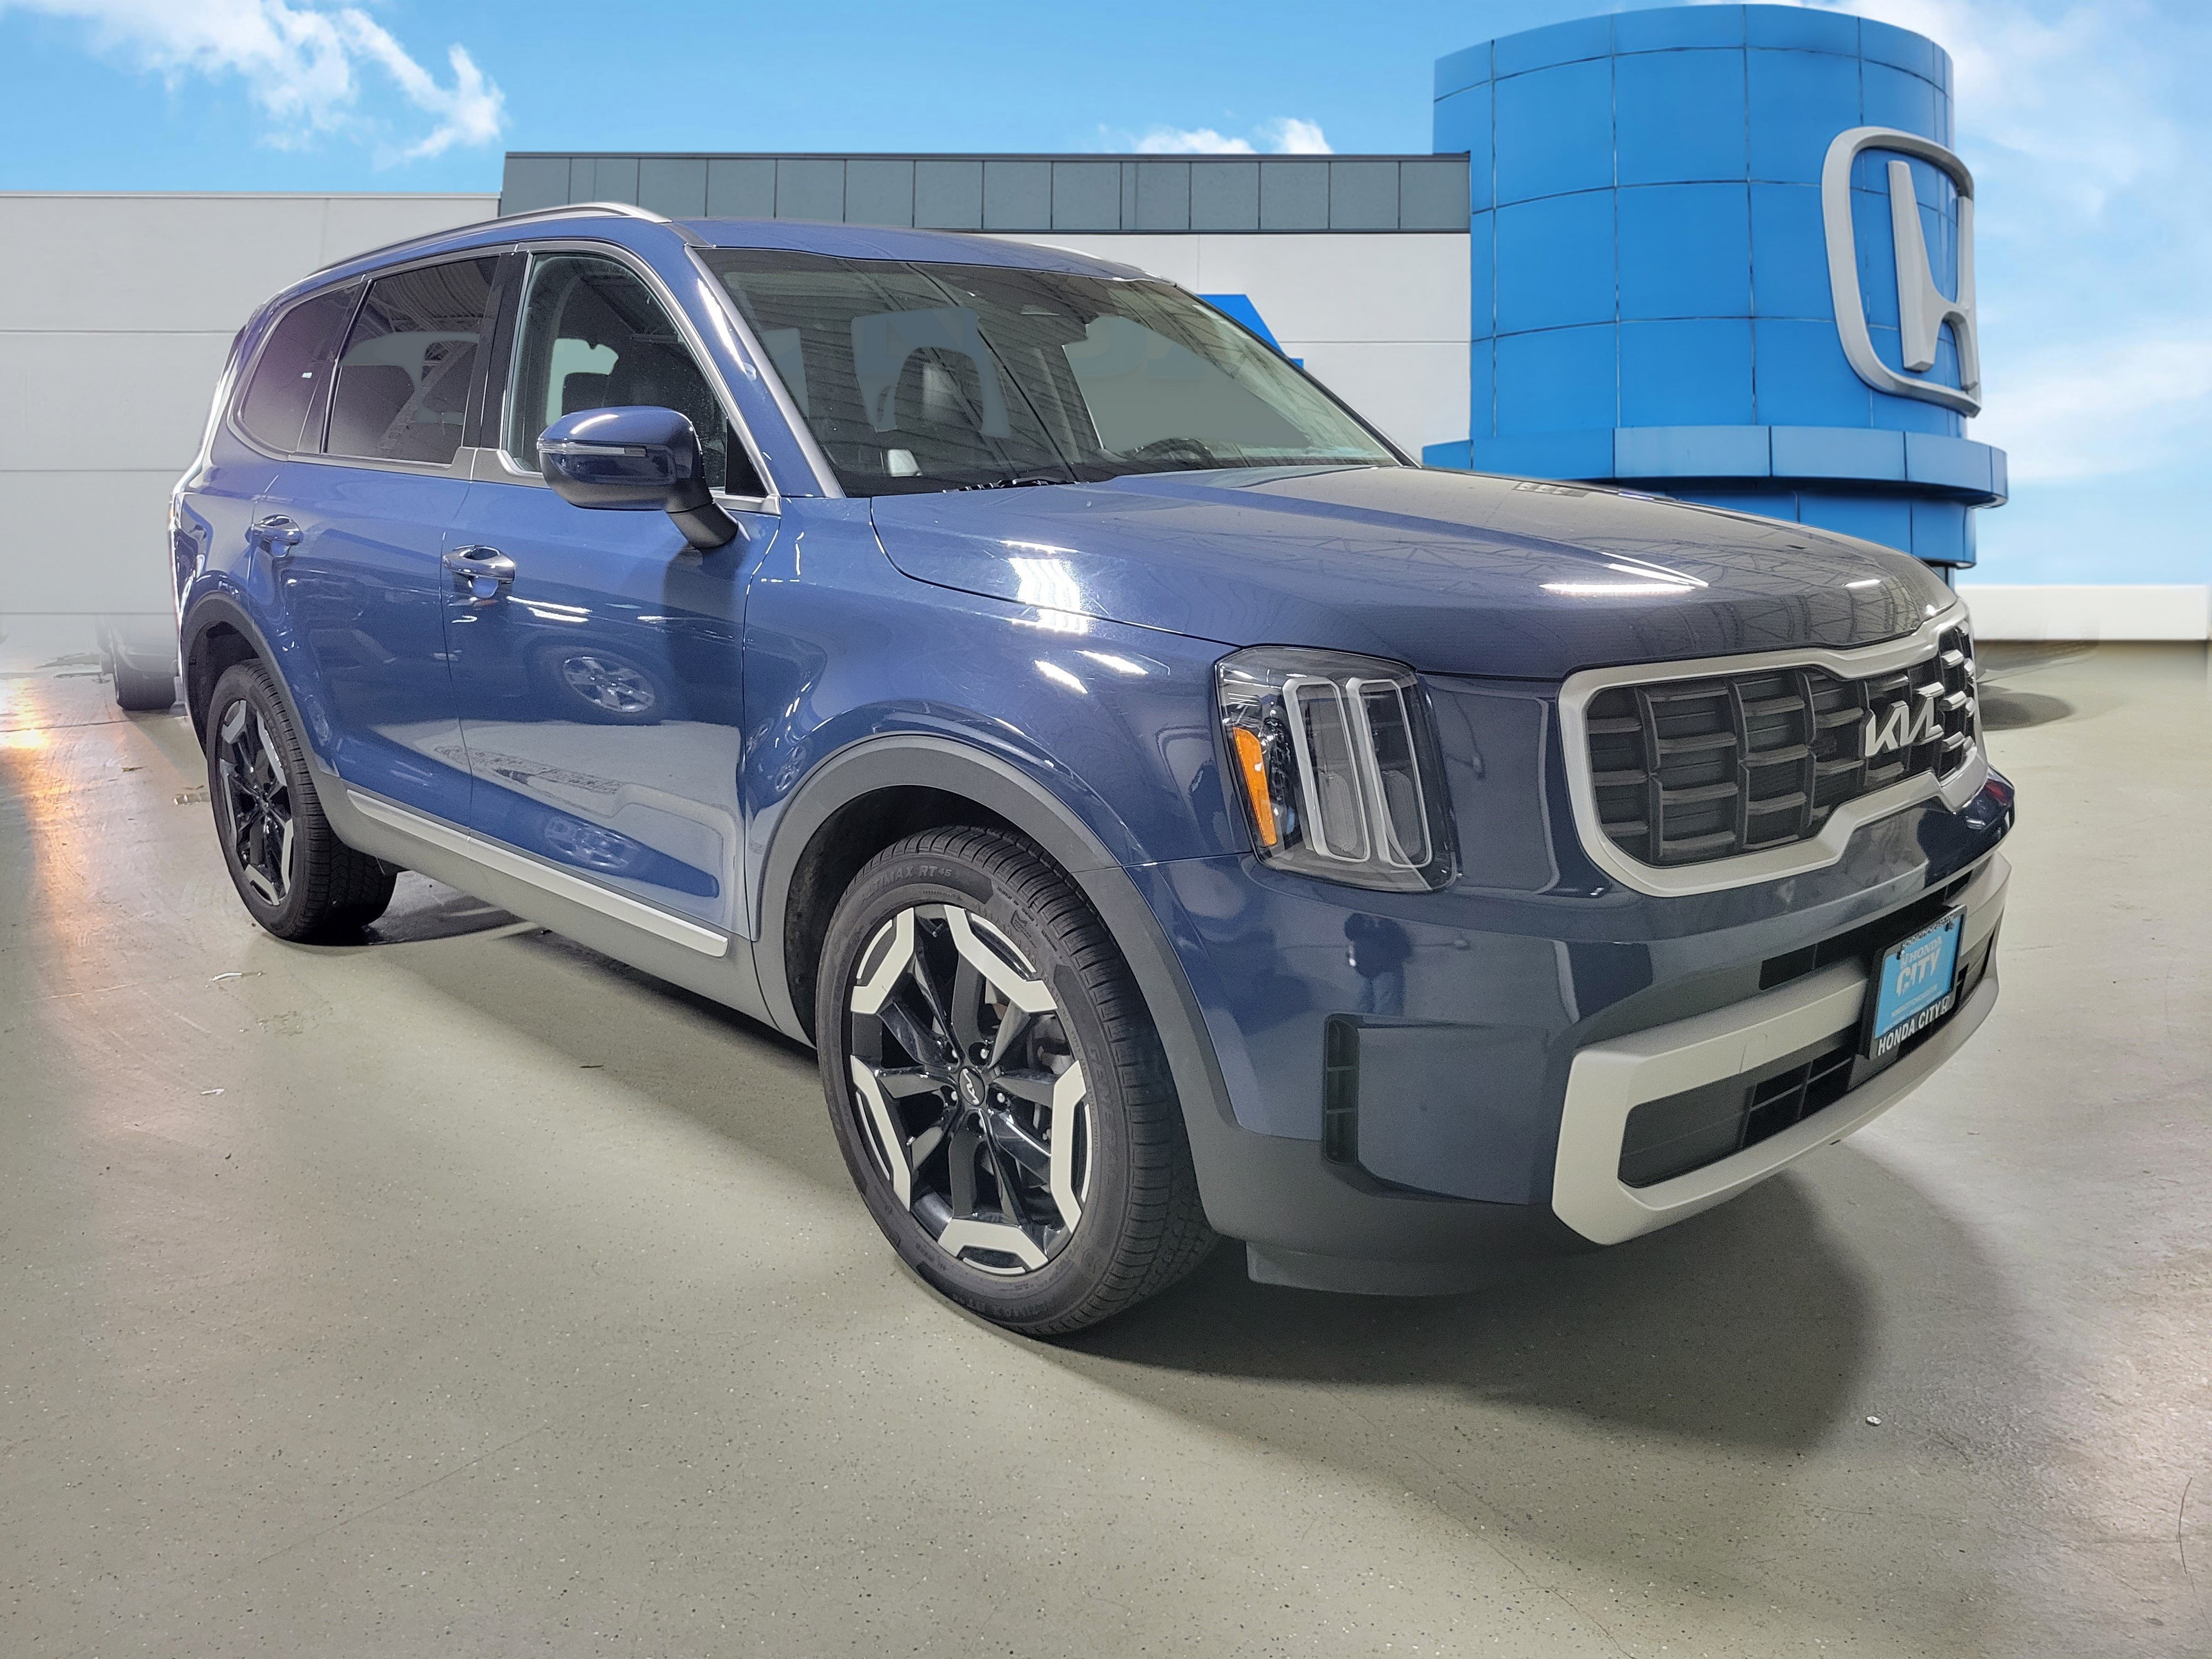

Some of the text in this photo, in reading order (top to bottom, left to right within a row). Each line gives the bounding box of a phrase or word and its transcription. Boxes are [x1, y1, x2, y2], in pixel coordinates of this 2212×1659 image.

[1896, 946, 1942, 996] CITY
[1910, 936, 1942, 959] HONDA
[1877, 1021, 1915, 1057] HONDA
[1918, 1001, 1942, 1028] CITY
